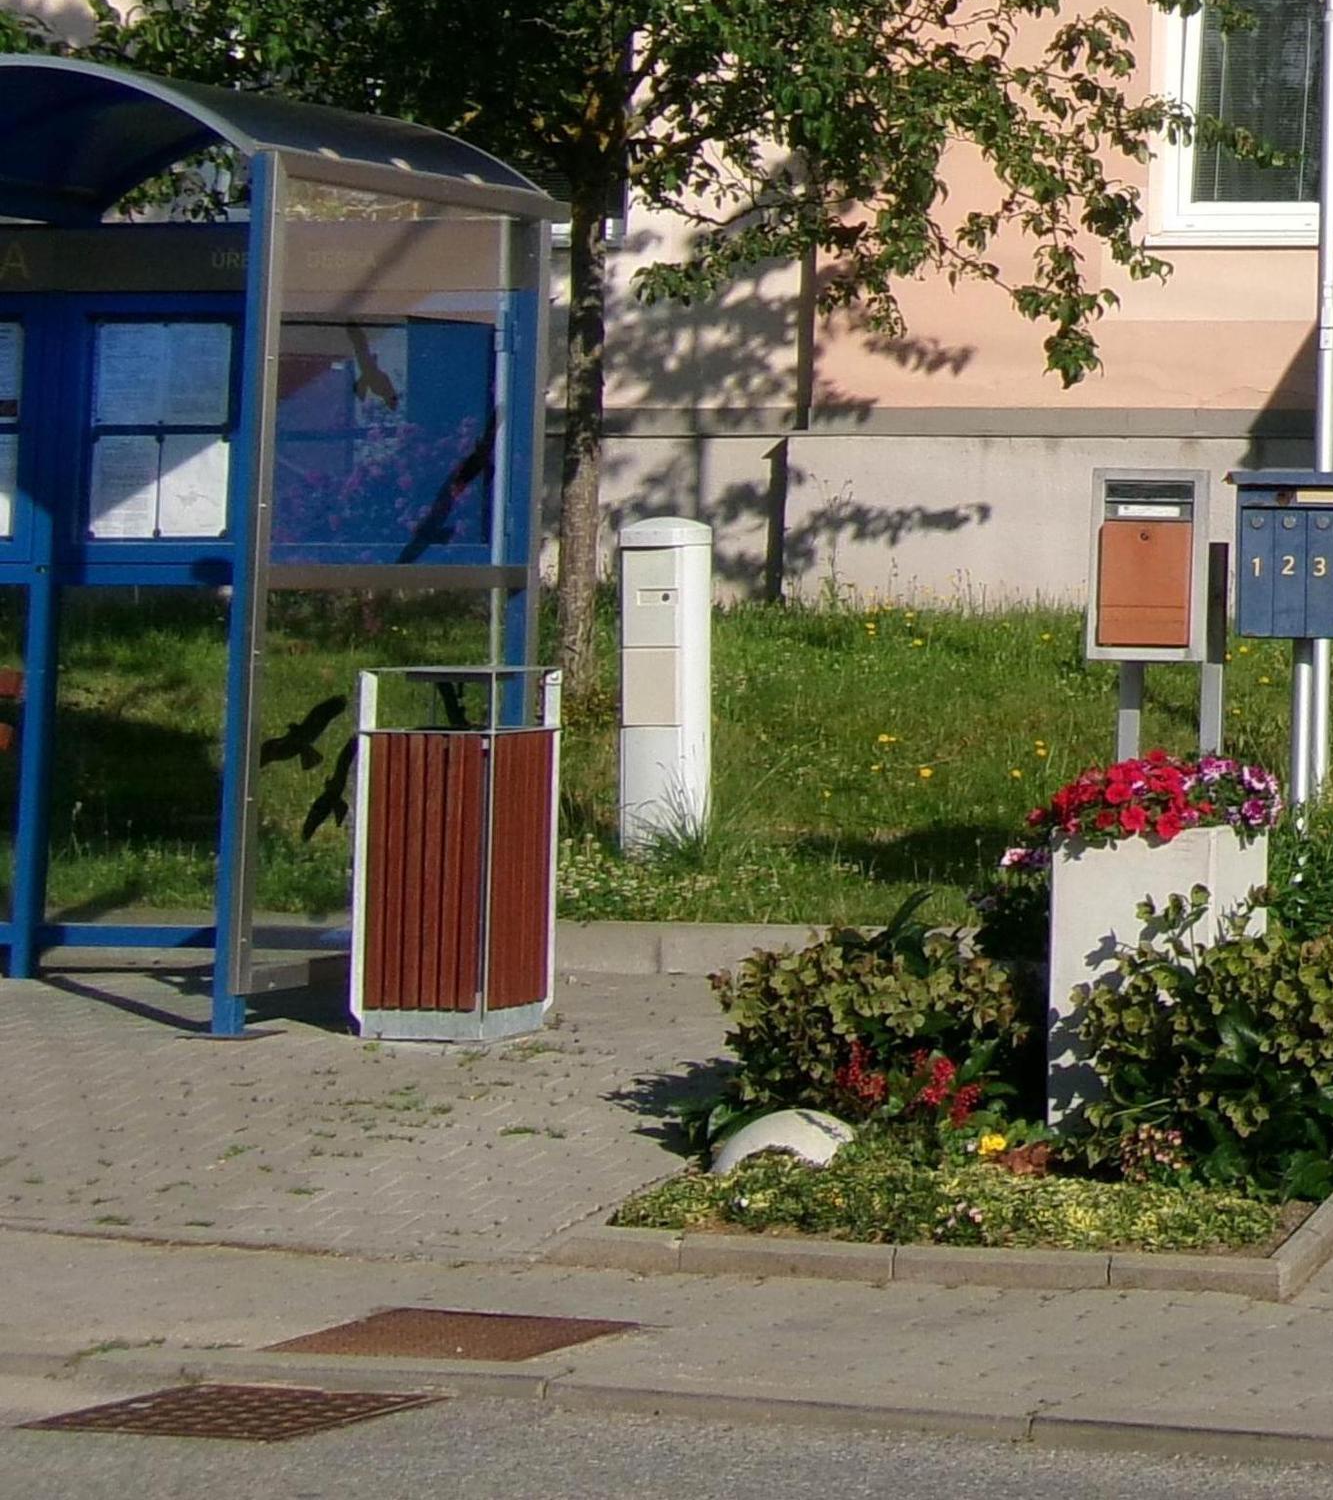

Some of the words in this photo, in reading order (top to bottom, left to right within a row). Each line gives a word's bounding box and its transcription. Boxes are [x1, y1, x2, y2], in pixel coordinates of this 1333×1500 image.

[1251, 556, 1261, 577] 1
[1281, 555, 1295, 575] 2
[1312, 556, 1326, 576] 3
